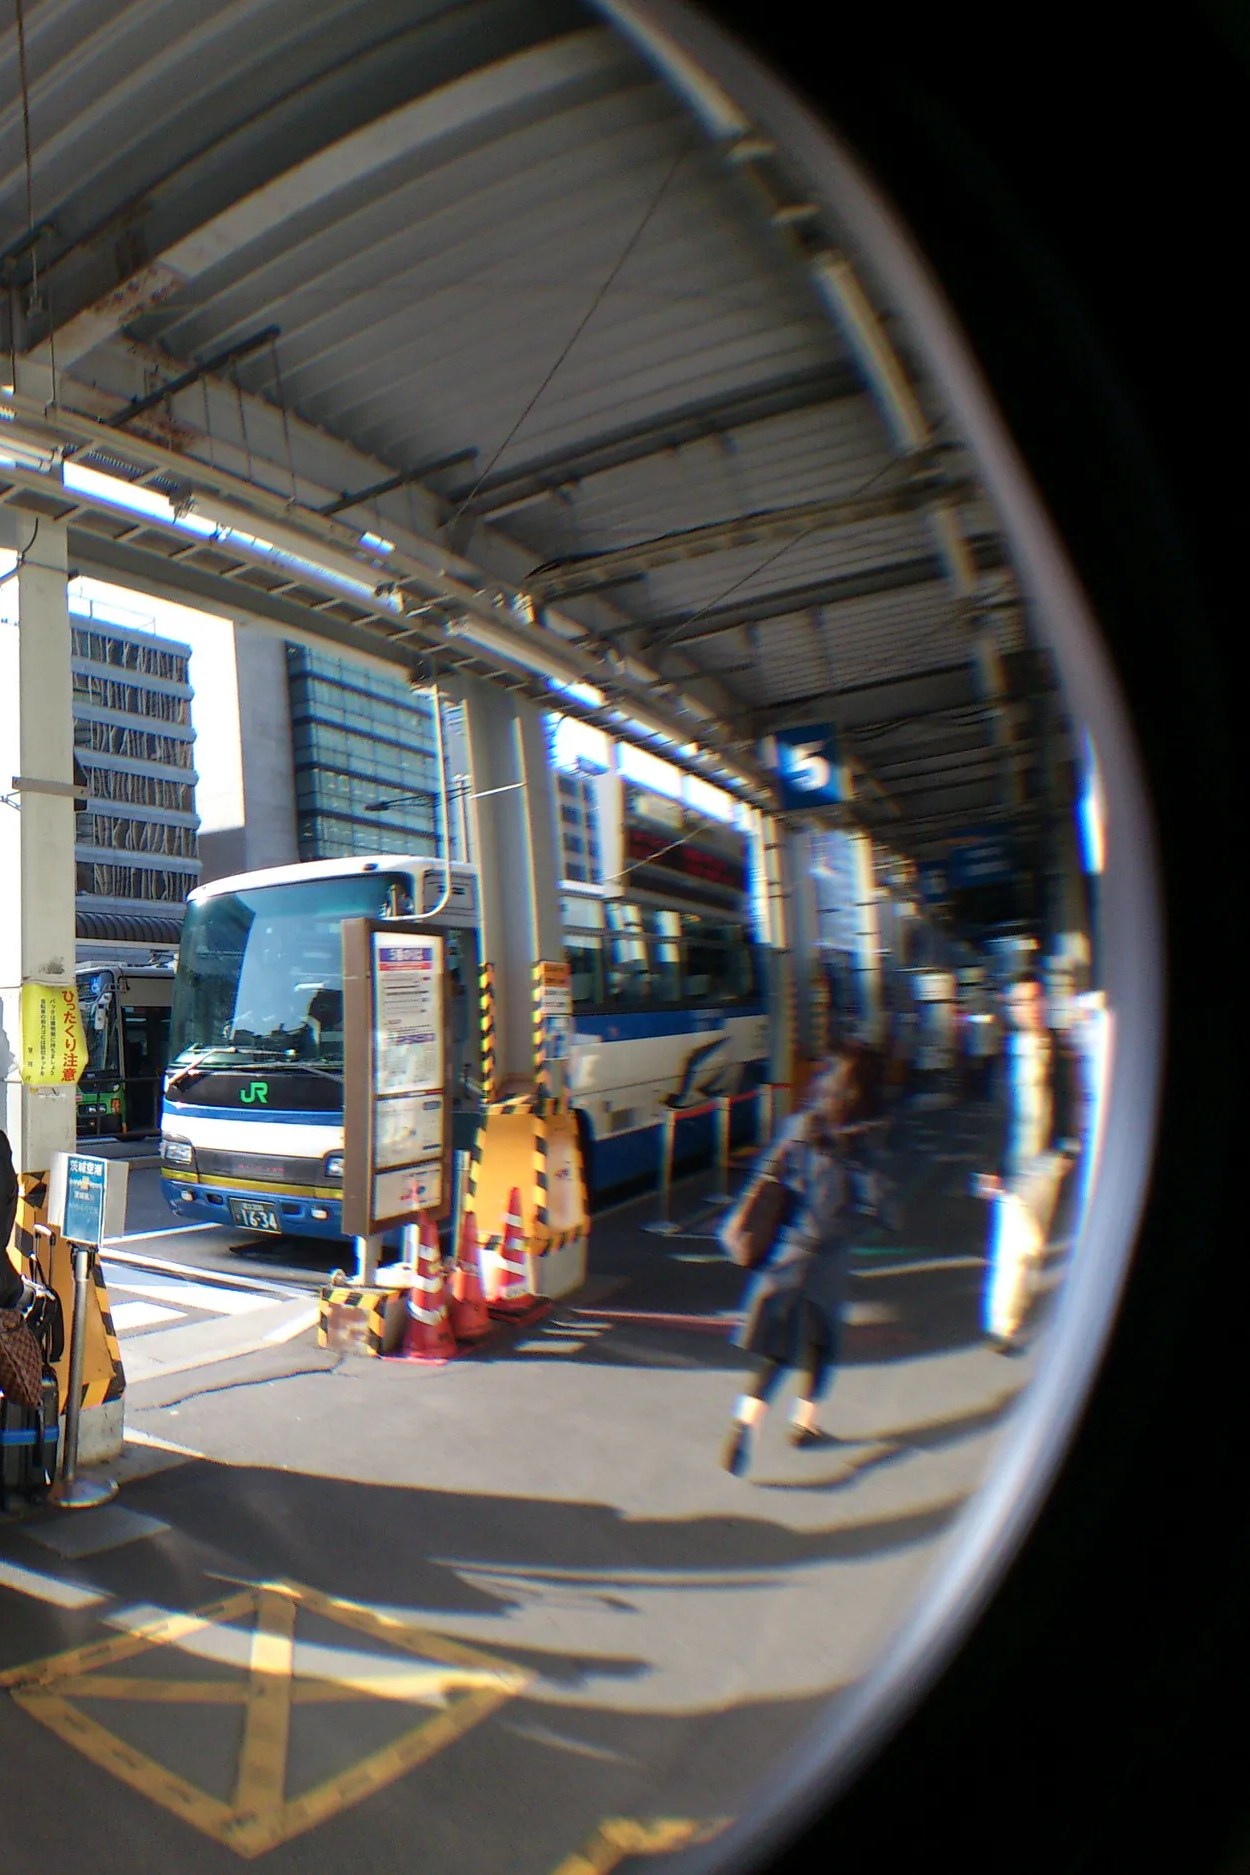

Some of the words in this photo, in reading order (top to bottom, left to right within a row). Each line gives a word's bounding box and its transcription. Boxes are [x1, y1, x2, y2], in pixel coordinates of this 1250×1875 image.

[787, 740, 830, 792] 5
[61, 990, 78, 1081] ひったくり注意
[240, 1082, 268, 1104] JR
[69, 1159, 103, 1176] 茨城空港
